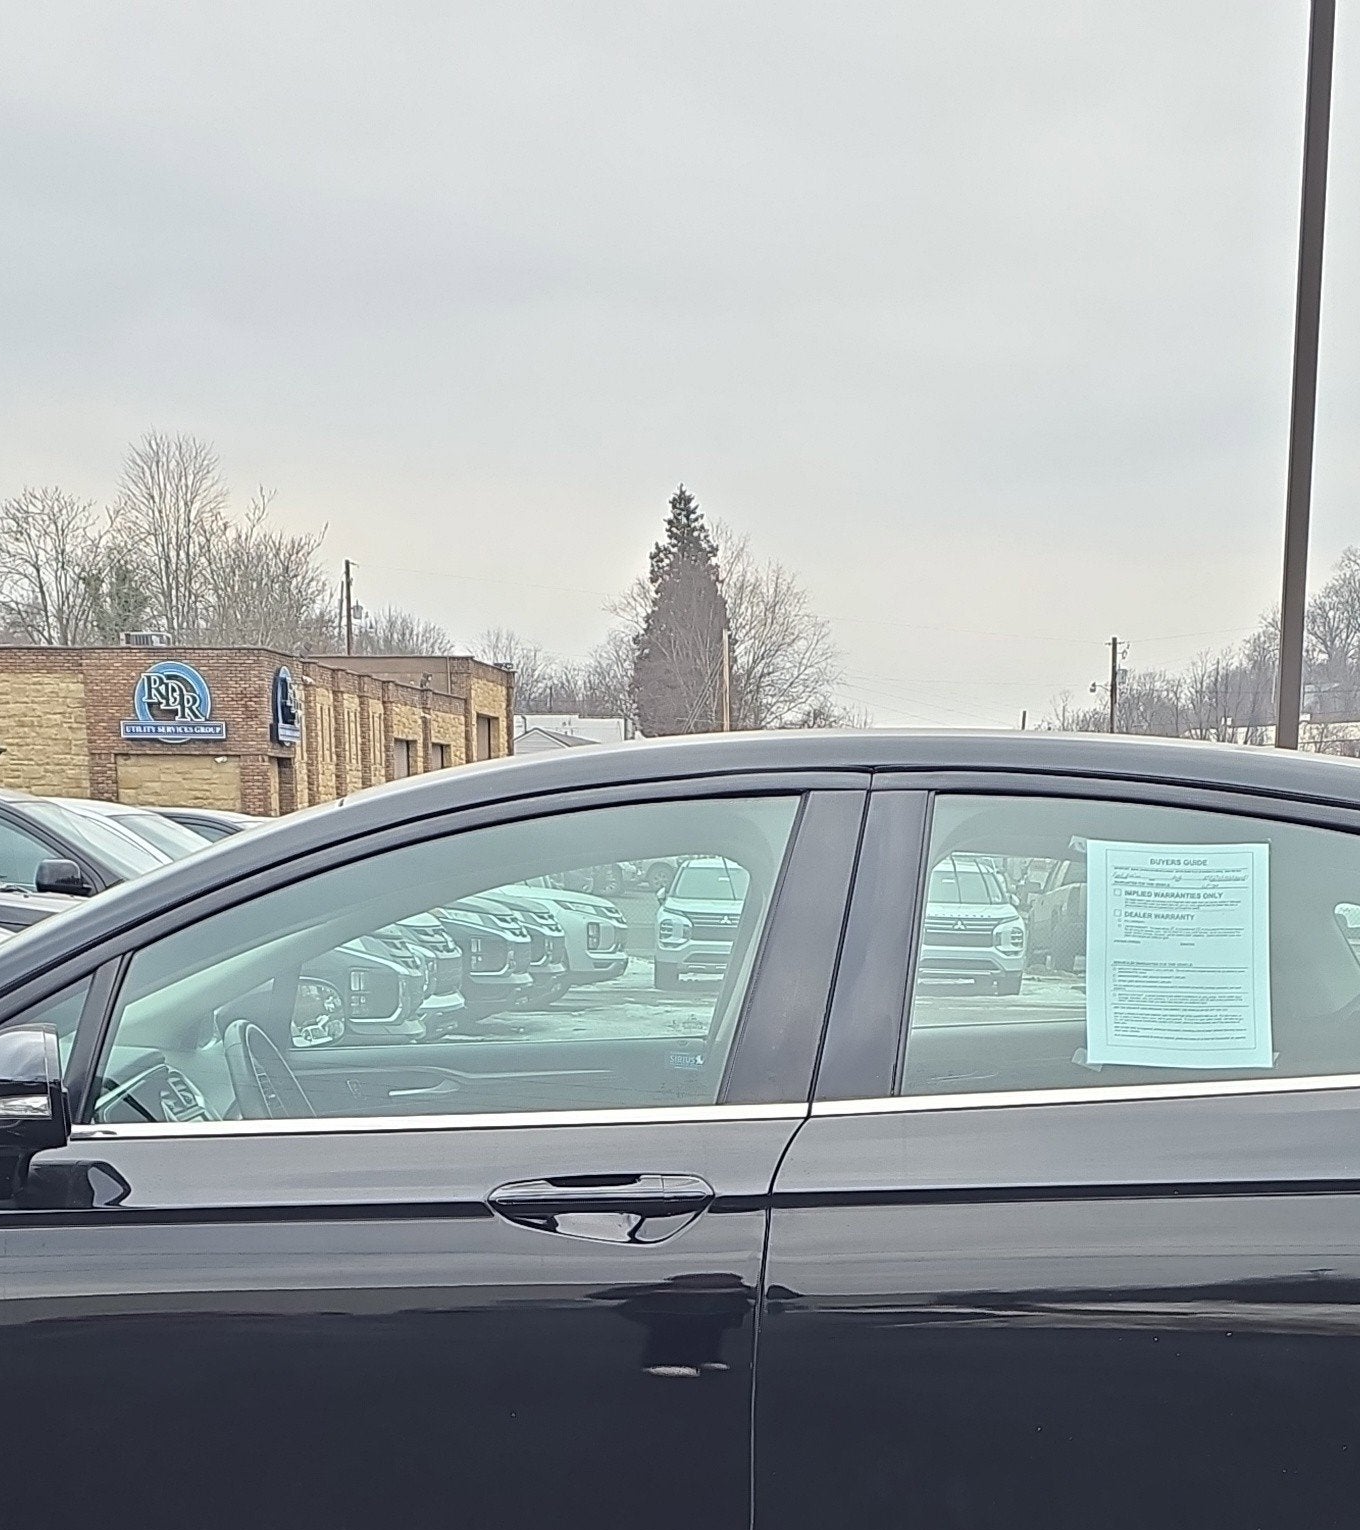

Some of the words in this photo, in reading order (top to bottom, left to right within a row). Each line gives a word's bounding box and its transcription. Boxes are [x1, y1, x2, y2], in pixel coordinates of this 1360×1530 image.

[141, 672, 206, 722] RDR
[125, 725, 156, 734] UTILITY
[157, 725, 194, 734] SERVICES
[194, 725, 221, 735] GROUP
[1149, 858, 1181, 866] BUYERS
[1183, 858, 1208, 867] GUIDE
[1124, 889, 1152, 898] IMPLIED
[1153, 890, 1201, 900] WARRANTIES
[1202, 891, 1224, 900] ONLY
[1124, 910, 1152, 919] DEALER
[1153, 912, 1195, 921] WARRANTY
